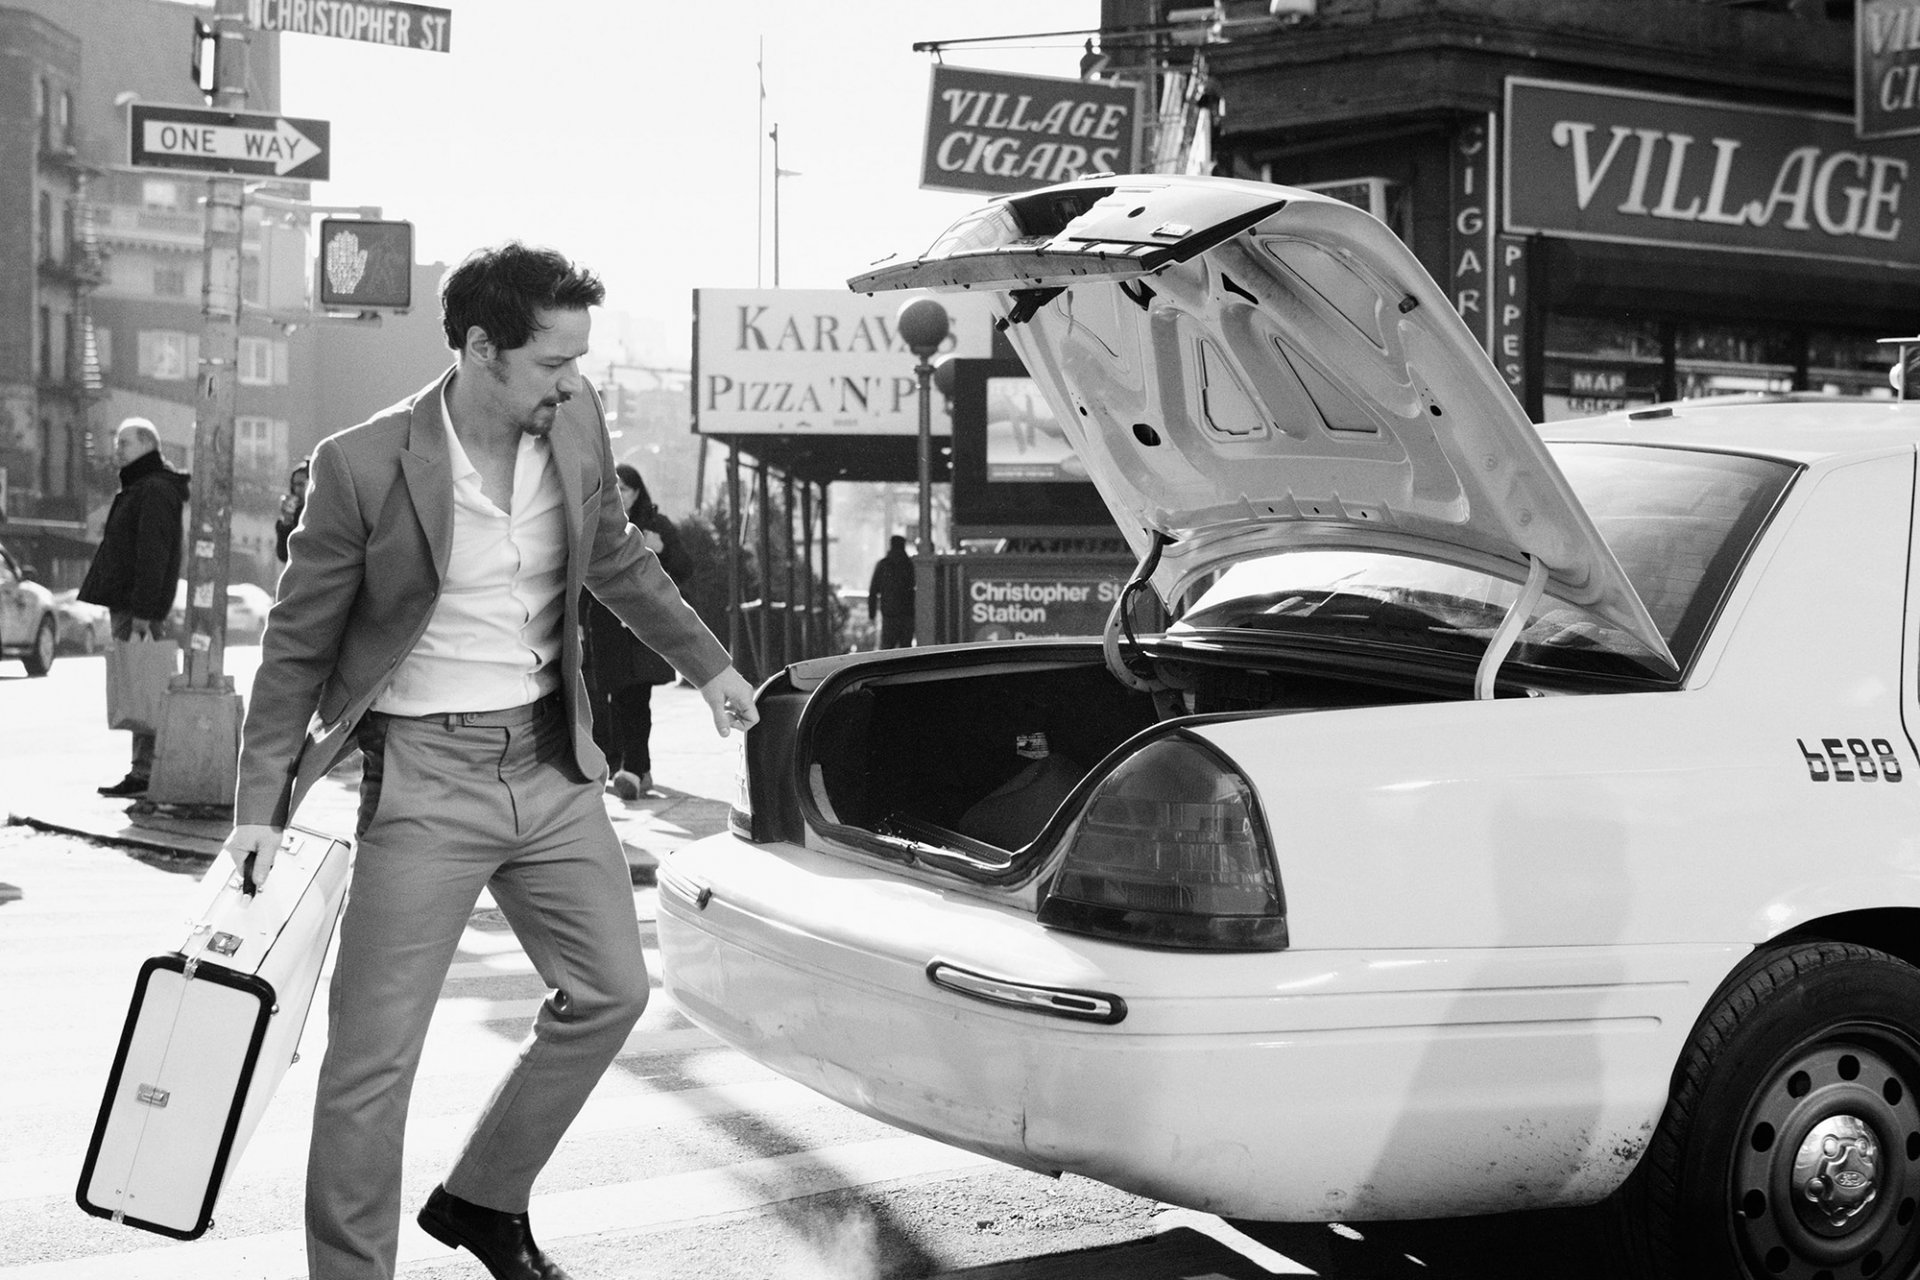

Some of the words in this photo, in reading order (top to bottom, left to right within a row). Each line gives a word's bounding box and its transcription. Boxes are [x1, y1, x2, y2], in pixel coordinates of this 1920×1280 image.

[262, 0, 411, 47] CHRISTOPHER
[420, 14, 447, 51] ST
[941, 88, 1128, 140] VILLAGE
[160, 126, 217, 153] ONE
[244, 133, 302, 160] WAY
[936, 131, 1120, 182] CIGARS
[1551, 120, 1909, 242] VILLAGE
[1503, 245, 1522, 385] PIPES
[707, 374, 822, 413] PIZZA
[1573, 371, 1625, 392] MAP
[970, 581, 1090, 605] Christopher
[972, 602, 1047, 623] Station
